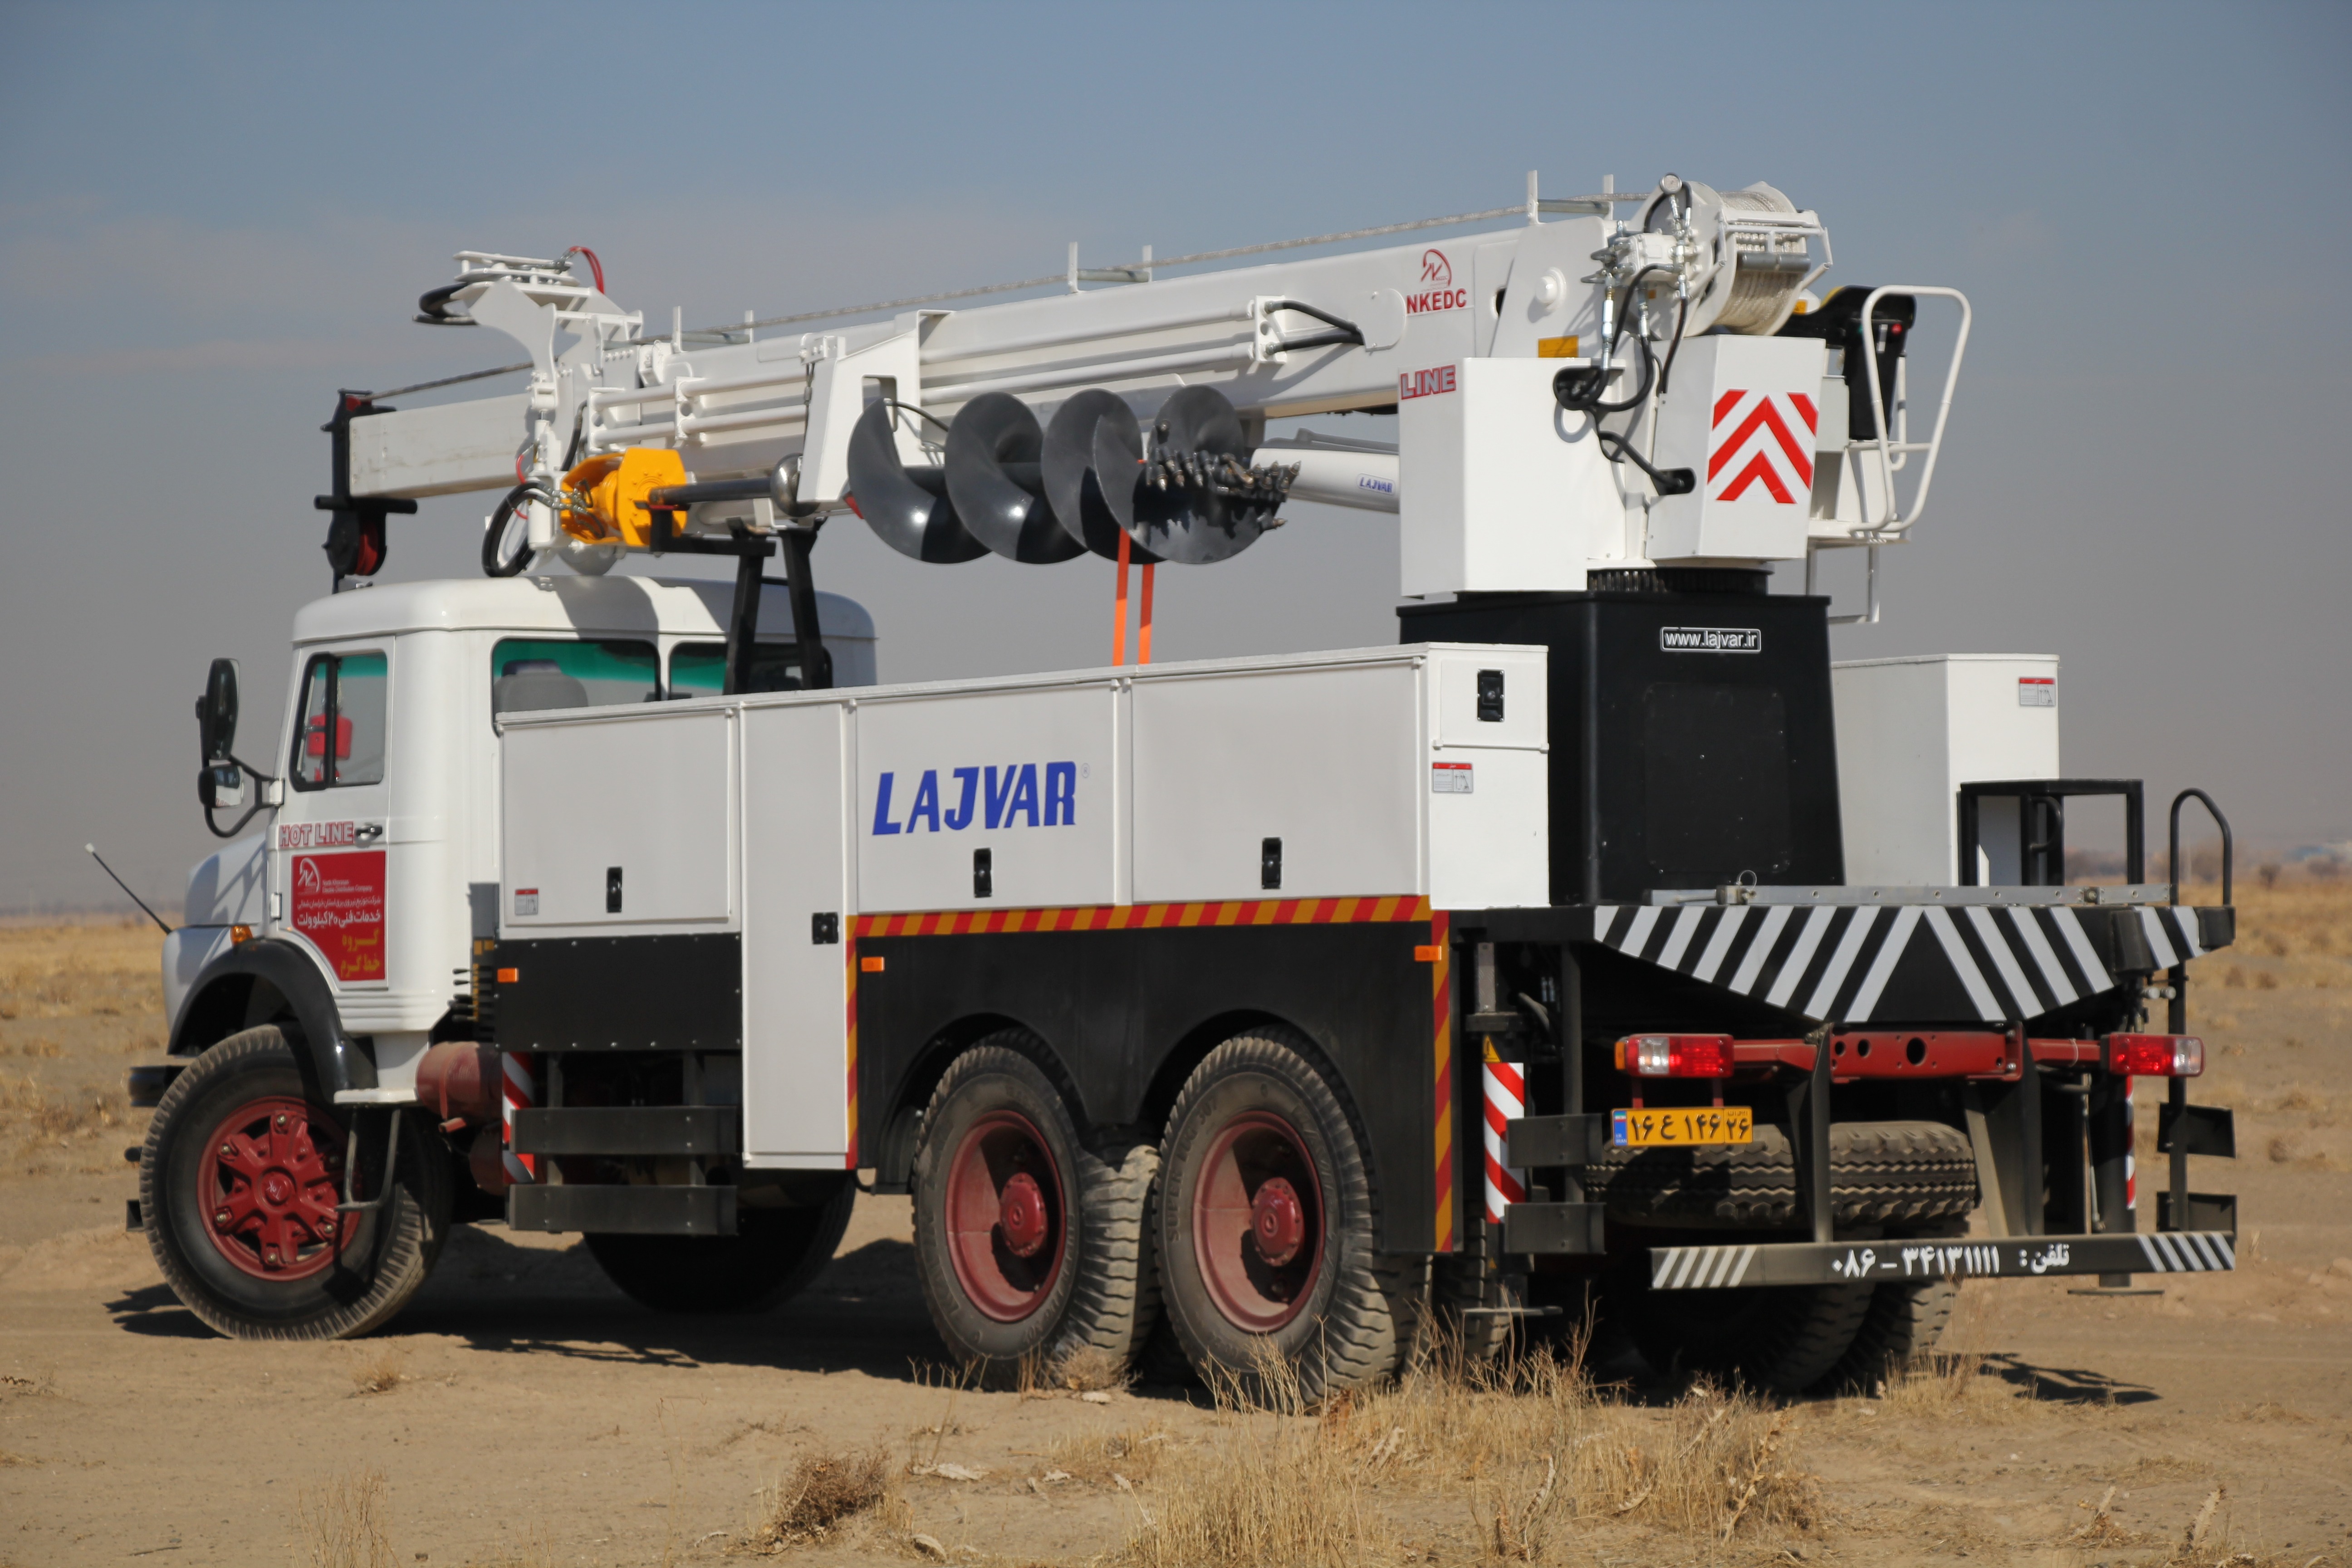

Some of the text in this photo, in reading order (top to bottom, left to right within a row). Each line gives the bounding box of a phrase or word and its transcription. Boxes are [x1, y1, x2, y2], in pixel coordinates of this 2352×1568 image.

[1407, 288, 1466, 314] NKEDC
[1401, 364, 1456, 400] LINE
[1664, 630, 1757, 649] www.lajvar.ir
[872, 761, 1077, 836] LAJVAR
[279, 821, 354, 848] HOT LINE
[338, 910, 354, 927] فنی
[354, 909, 381, 922] خدمات
[1726, 1118, 1750, 1140] ۲۶
